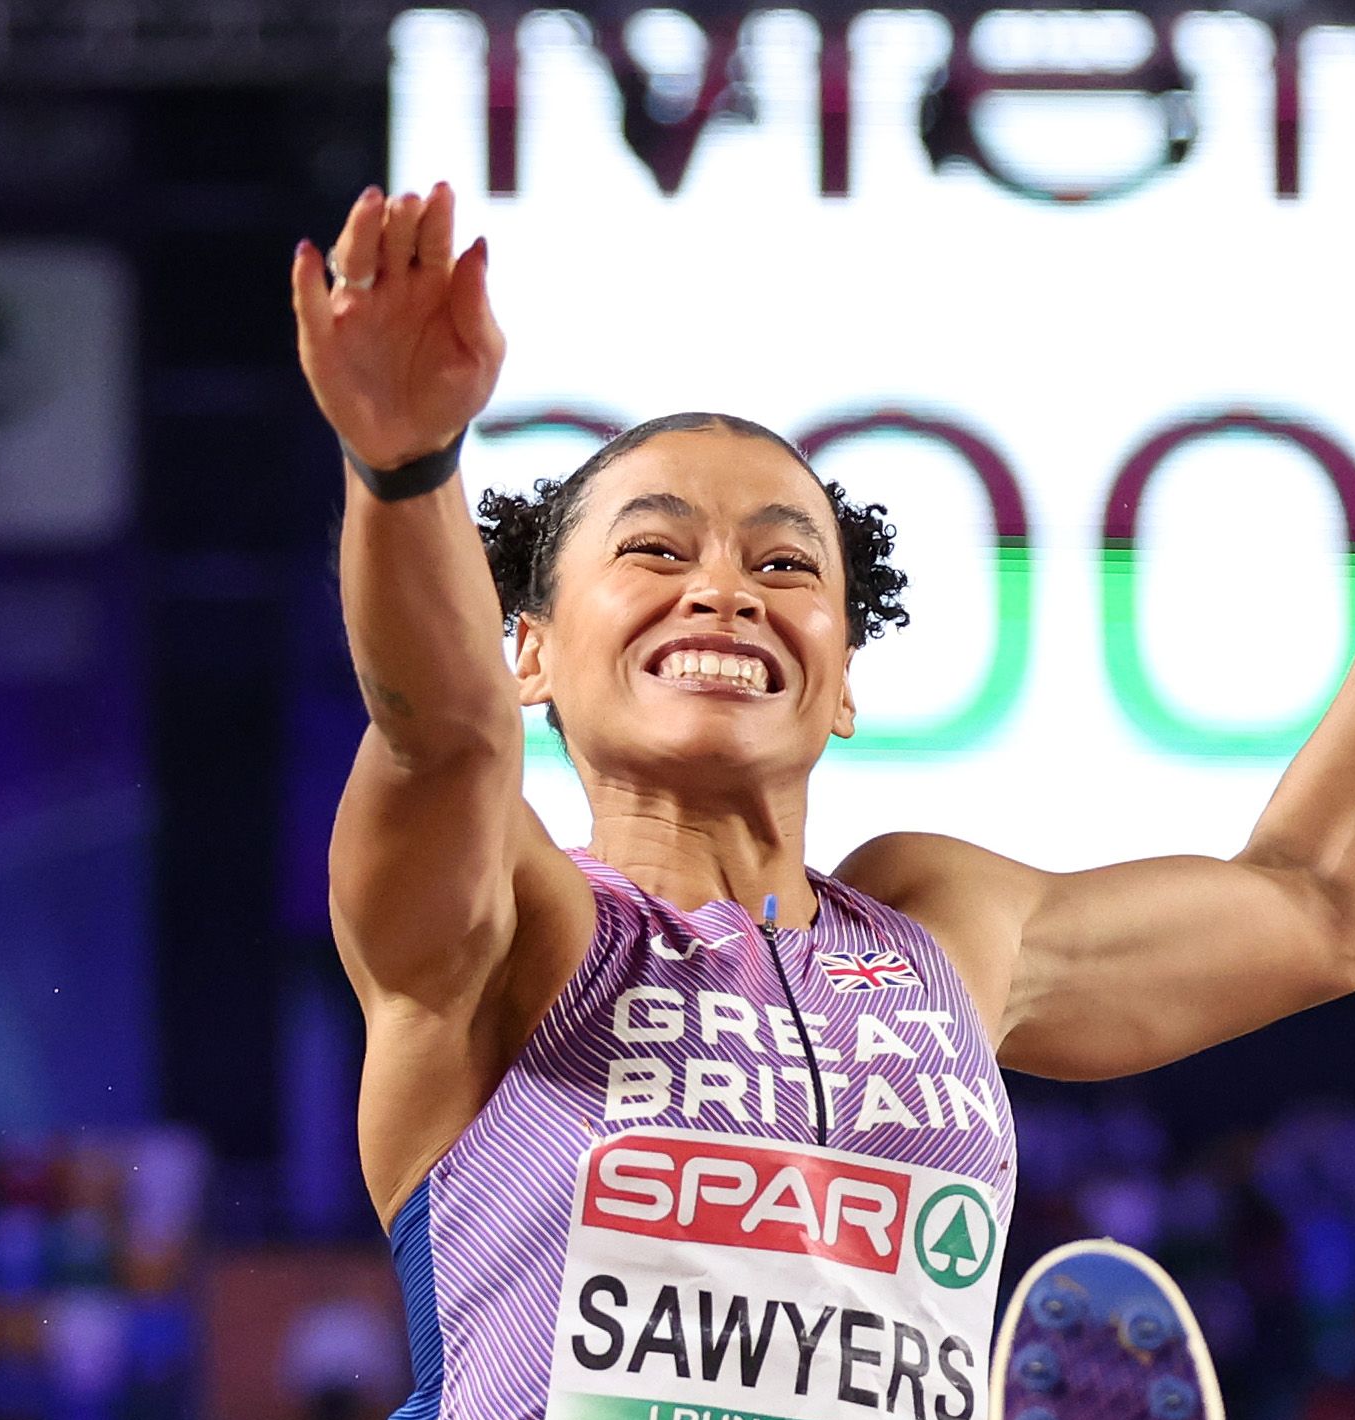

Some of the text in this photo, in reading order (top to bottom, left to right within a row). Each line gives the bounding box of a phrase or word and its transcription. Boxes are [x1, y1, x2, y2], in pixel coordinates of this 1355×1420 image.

[612, 984, 959, 1061] GREAT
[604, 1057, 1002, 1138] BRITAIN
[594, 1148, 899, 1257] SPAR
